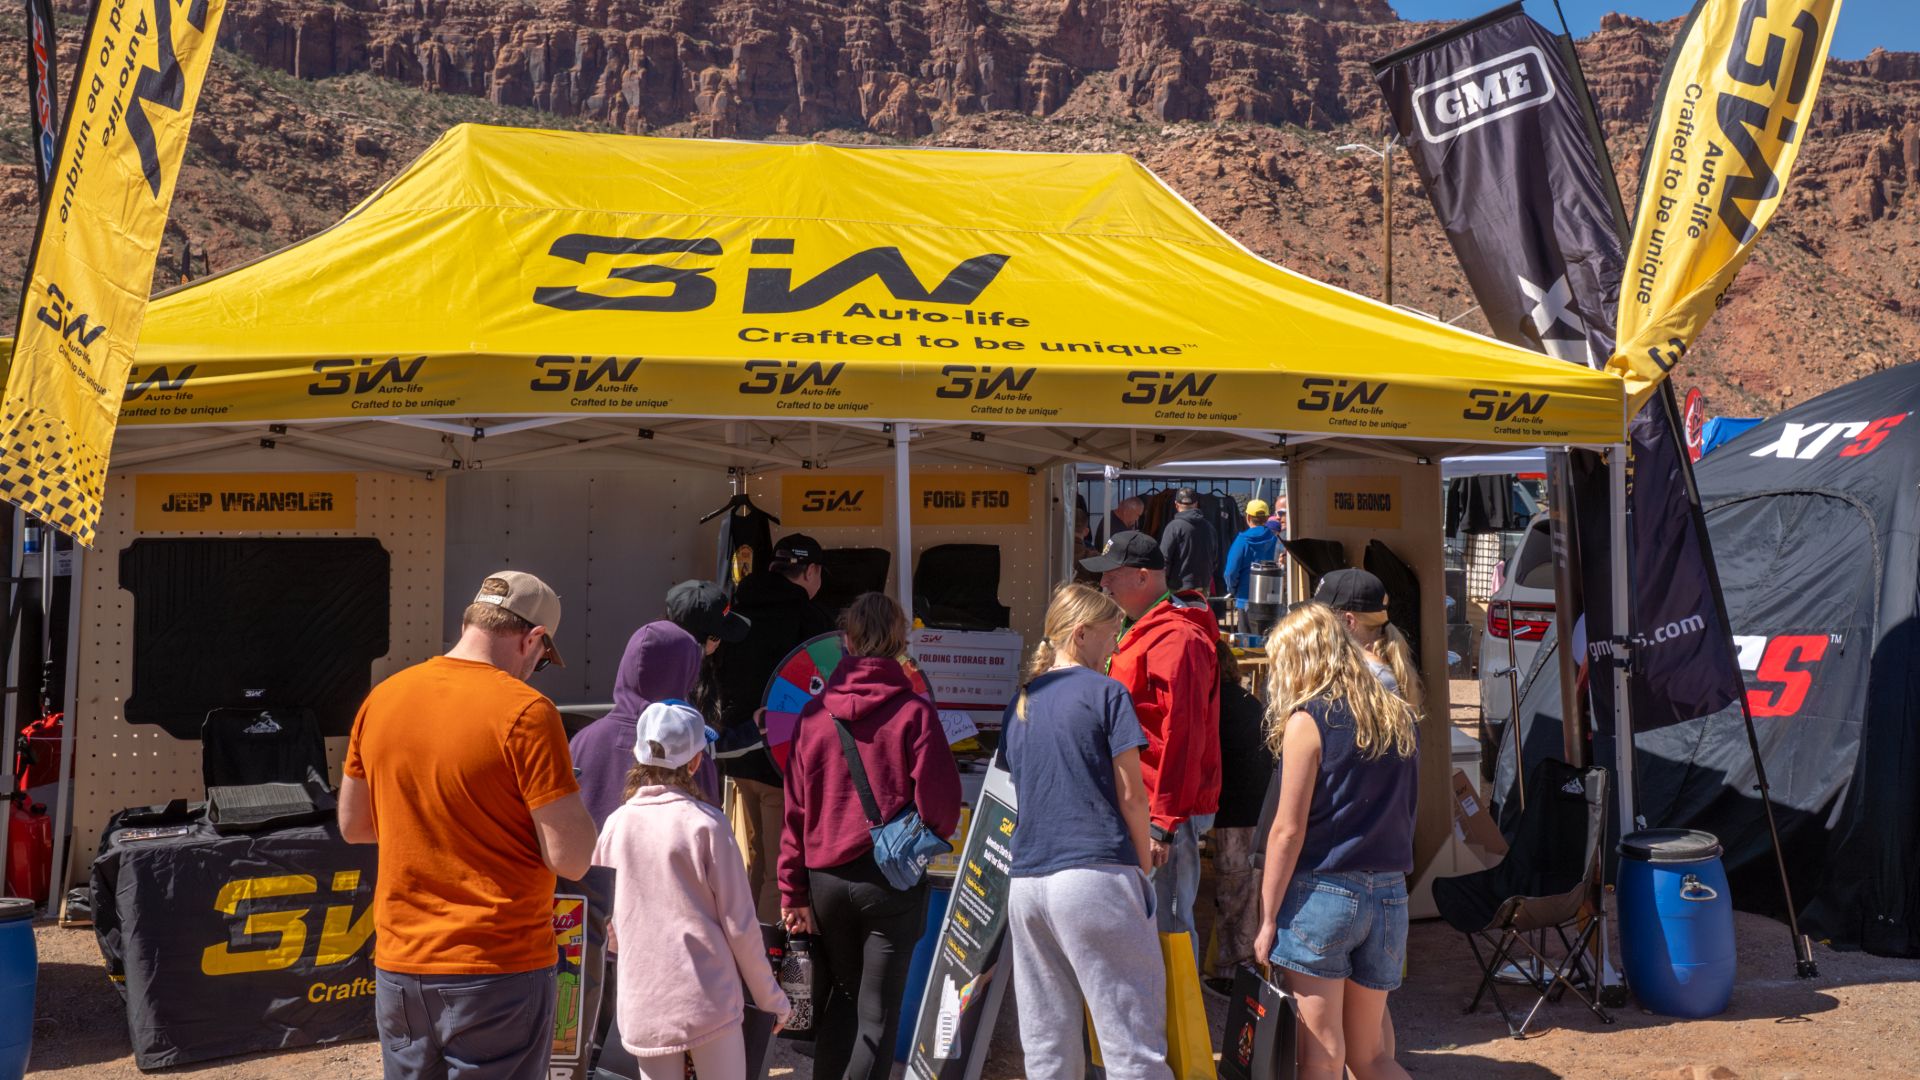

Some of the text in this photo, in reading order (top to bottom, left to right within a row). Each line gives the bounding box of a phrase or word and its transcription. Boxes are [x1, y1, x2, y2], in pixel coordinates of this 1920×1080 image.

[100, 35, 115, 67] to
[102, 8, 148, 147] Auto-life
[87, 73, 105, 113] be
[1435, 63, 1531, 124] GME
[1670, 83, 1703, 164] Crafted
[1667, 169, 1683, 189] to
[1688, 140, 1724, 239] Auto-life
[1656, 195, 1677, 224] be
[843, 302, 1031, 328] Auto-life
[737, 326, 903, 348] Crafted
[916, 333, 960, 351] to
[975, 335, 1025, 352] be
[378, 384, 424, 394] Auto-life
[595, 383, 638, 393] Auto-life
[801, 387, 841, 396] Auto-life
[144, 392, 194, 401] Auto-life
[993, 392, 1032, 401] Auto-life
[351, 400, 389, 409] Crafted
[392, 400, 402, 408] to
[405, 399, 417, 408] be
[571, 398, 605, 407] Crafted
[608, 399, 618, 407] to
[621, 398, 632, 407] be
[776, 400, 810, 410] Crafted
[813, 401, 822, 410] to
[824, 401, 835, 410] be
[1176, 398, 1213, 407] Auto-life
[160, 408, 171, 416] to
[174, 406, 187, 415] be
[971, 405, 1002, 414] Crafted
[1005, 406, 1014, 414] to
[1016, 406, 1026, 415] be
[1155, 410, 1184, 419] Crafted
[1187, 411, 1195, 419] to
[1197, 411, 1207, 420] be
[1350, 406, 1384, 415] Auto-life
[1329, 417, 1357, 426] Crafted
[1359, 419, 1367, 427] to
[1369, 419, 1379, 428] be
[1511, 415, 1543, 424] Auto-life
[1494, 426, 1521, 435] Crafted
[1532, 428, 1541, 436] be
[162, 491, 333, 512] JEEP WRANGLER
[923, 490, 1009, 508] FORD F150
[1334, 492, 1391, 512] FORD BRONCO
[919, 654, 1005, 666] FOLDING STORAGE BOX
[307, 977, 377, 1003] Crafte
